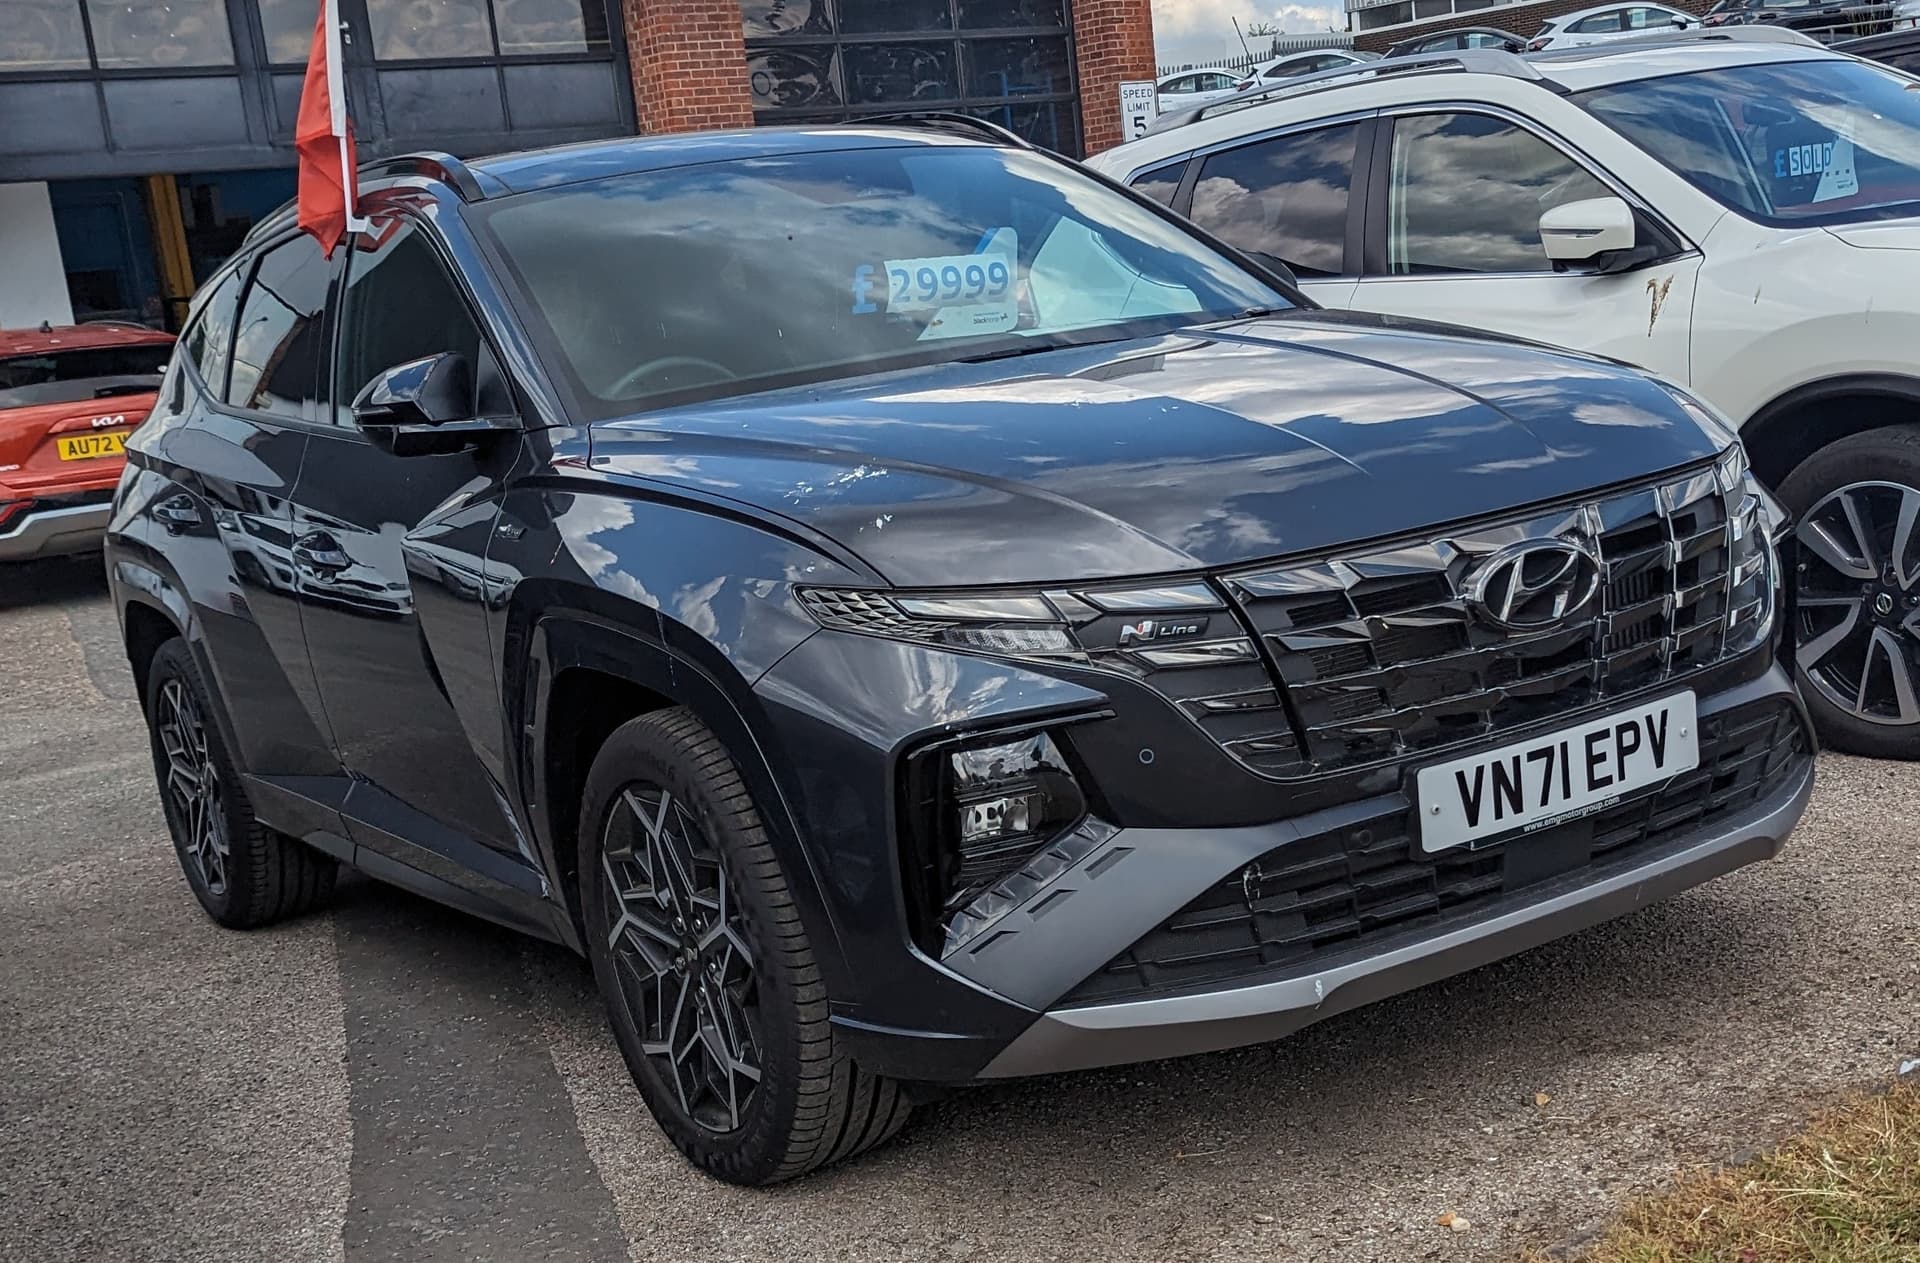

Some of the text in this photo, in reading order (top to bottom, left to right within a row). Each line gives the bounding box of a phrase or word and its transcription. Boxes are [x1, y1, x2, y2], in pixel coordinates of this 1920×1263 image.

[1122, 88, 1153, 99] SPEED
[1127, 101, 1151, 112] LIMIT
[1133, 115, 1147, 138] 5
[1791, 146, 1832, 172] SOLD
[68, 436, 113, 456] AU72
[1455, 708, 1669, 828] VN71 EPV
[1522, 796, 1621, 833] www.emgmotorgroup.com
